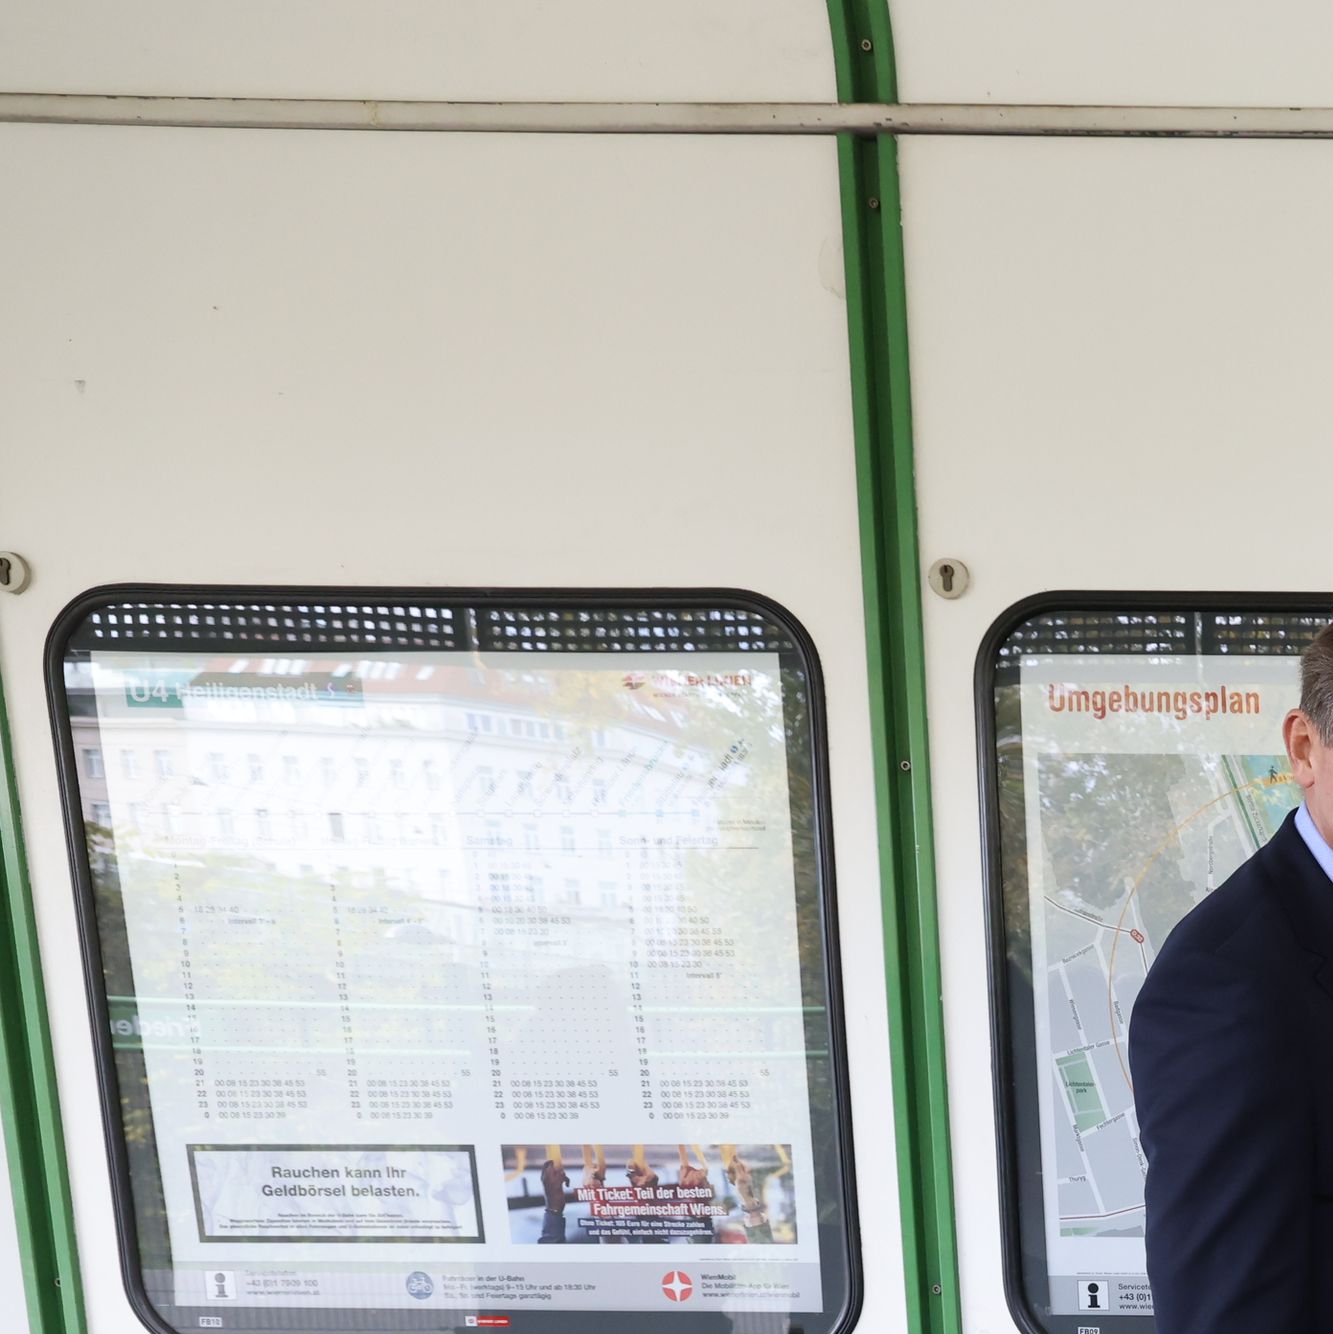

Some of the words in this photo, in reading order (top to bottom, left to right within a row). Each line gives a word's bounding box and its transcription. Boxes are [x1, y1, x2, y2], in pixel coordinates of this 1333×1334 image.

[129, 679, 168, 703] U4
[1048, 683, 1260, 720] Umgebungsplan
[271, 1166, 341, 1179] Rauchen
[344, 1166, 382, 1179] kann
[386, 1166, 407, 1179] Ihr
[262, 1184, 347, 1198] Geldbörsel
[351, 1184, 421, 1198] belasten.
[577, 1188, 597, 1201] Mit
[597, 1187, 635, 1201] Ticket:
[635, 1187, 655, 1199] Teil
[656, 1186, 675, 1199] der
[676, 1186, 713, 1198] besten
[593, 1203, 690, 1218] Fahrgemeinschaft
[690, 1203, 727, 1216] Wiens.
